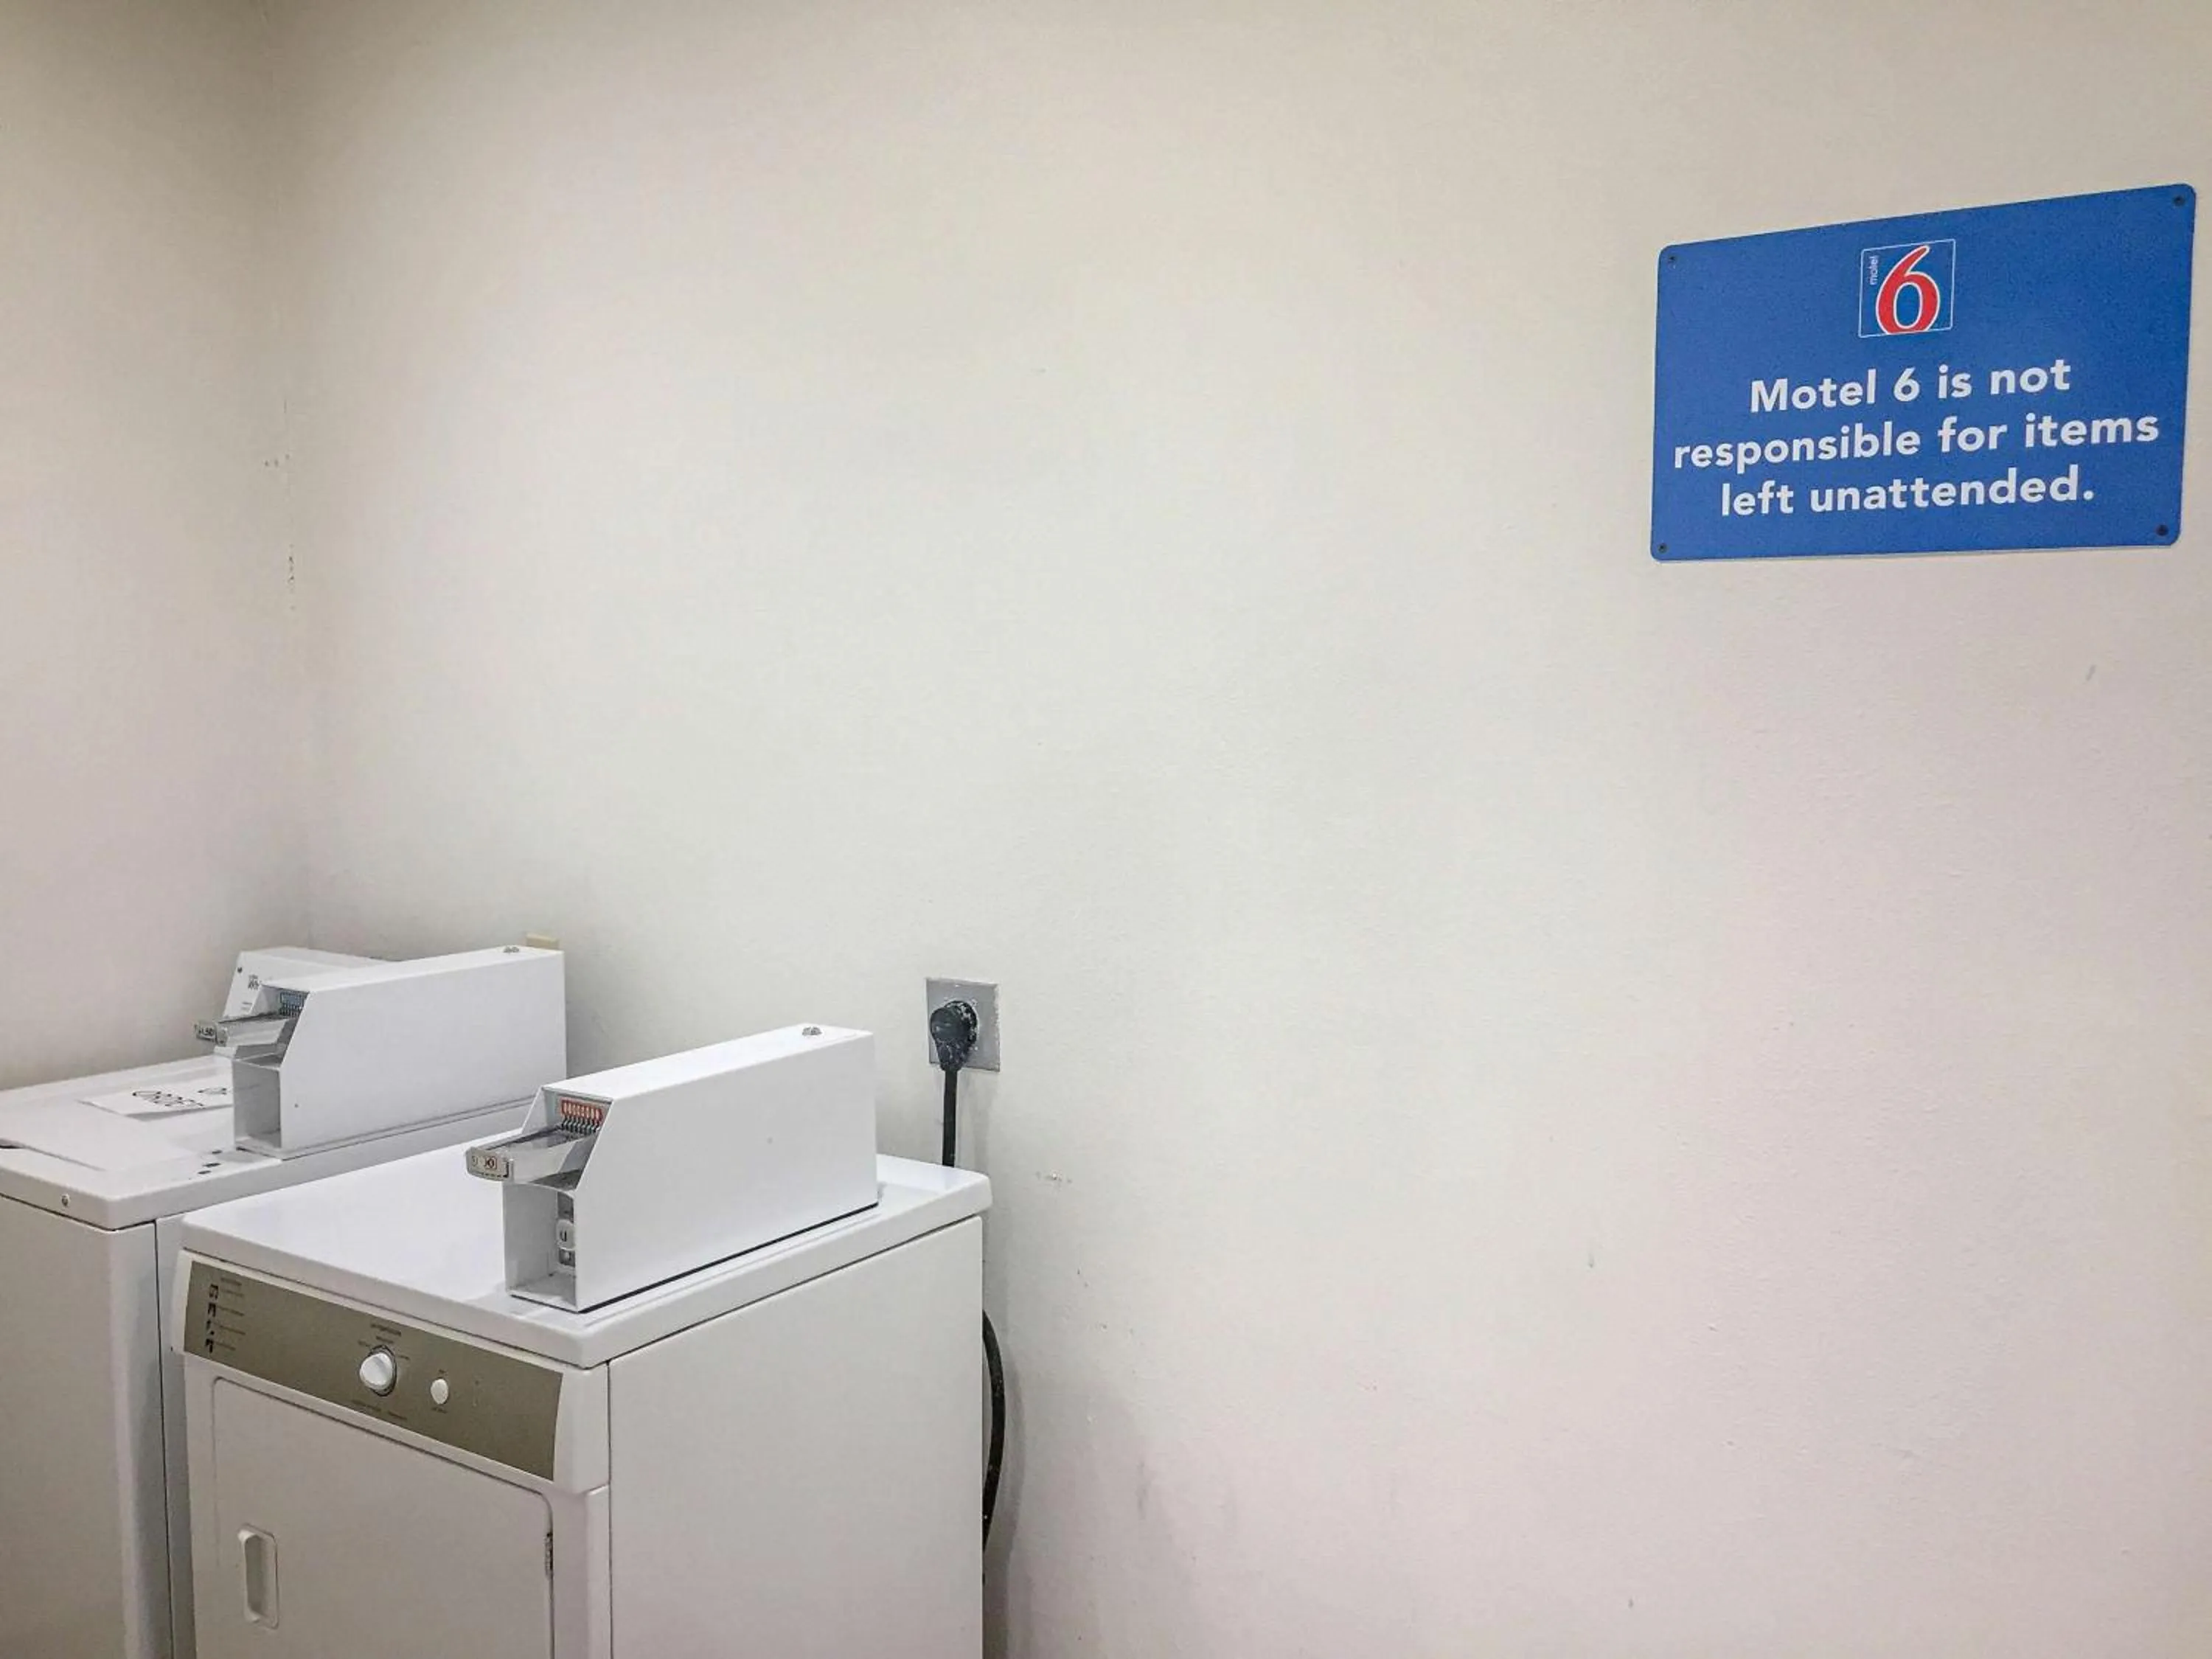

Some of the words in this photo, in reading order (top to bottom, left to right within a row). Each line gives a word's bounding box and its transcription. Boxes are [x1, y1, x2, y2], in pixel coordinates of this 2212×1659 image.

[1868, 254, 1879, 285] motel
[1875, 245, 1941, 335] 6
[1750, 368, 1877, 413] Motel
[1893, 367, 1920, 403] 6
[1938, 364, 1972, 400] is
[1989, 358, 2072, 394] not
[1674, 421, 1921, 475] responsible
[1937, 415, 2008, 453] for
[2025, 411, 2159, 448] items
[1721, 480, 1794, 516] left
[1809, 464, 2094, 512] unattended.
